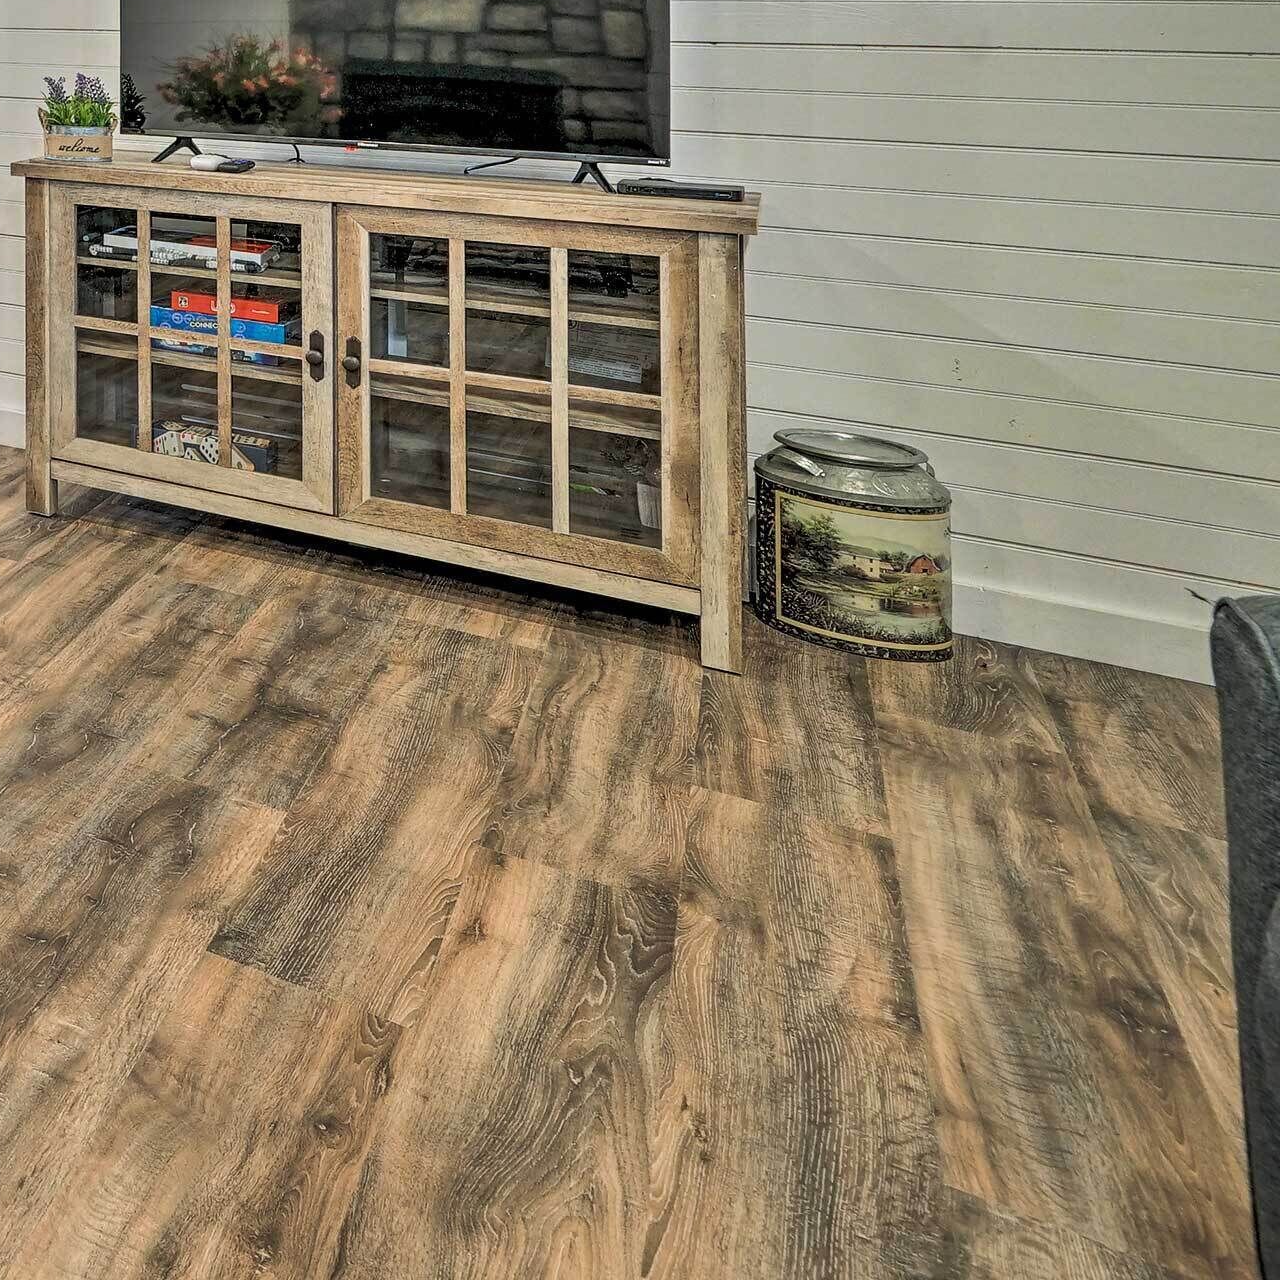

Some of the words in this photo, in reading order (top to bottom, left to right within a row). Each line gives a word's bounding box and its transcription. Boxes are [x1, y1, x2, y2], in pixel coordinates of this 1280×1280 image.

[58, 138, 101, 153] welcome
[210, 300, 236, 314] UO
[189, 321, 219, 329] CONNEC
